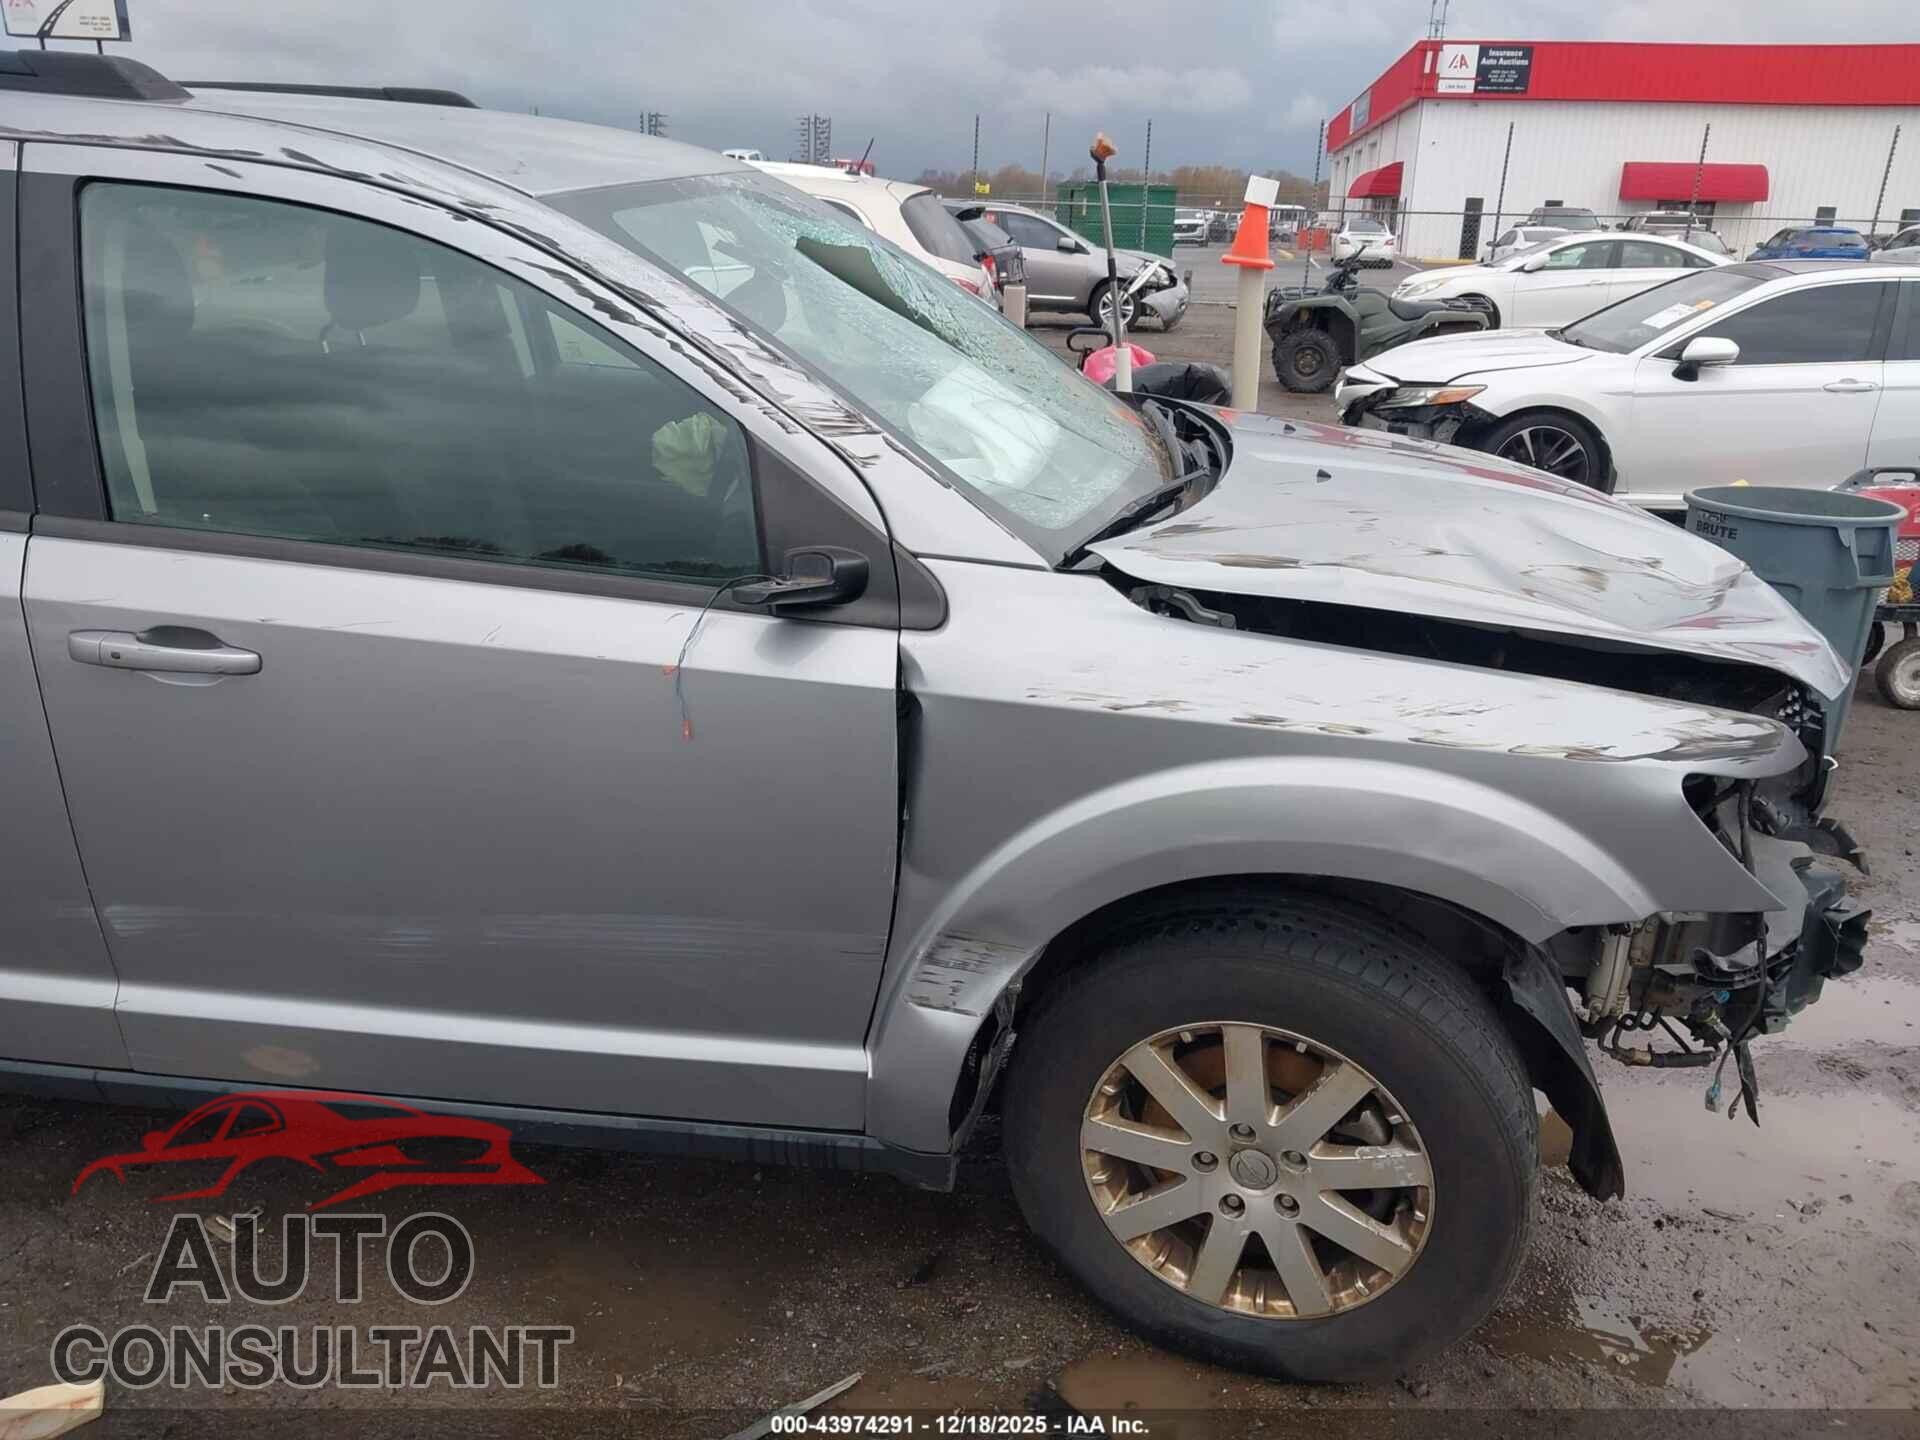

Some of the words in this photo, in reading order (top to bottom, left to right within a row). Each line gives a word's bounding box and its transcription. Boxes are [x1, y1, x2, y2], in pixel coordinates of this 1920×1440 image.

[1488, 48, 1523, 57] Insurance
[1480, 57, 1497, 65] Auto
[1498, 57, 1529, 66] Auctions
[1695, 519, 1738, 540] BRUTE
